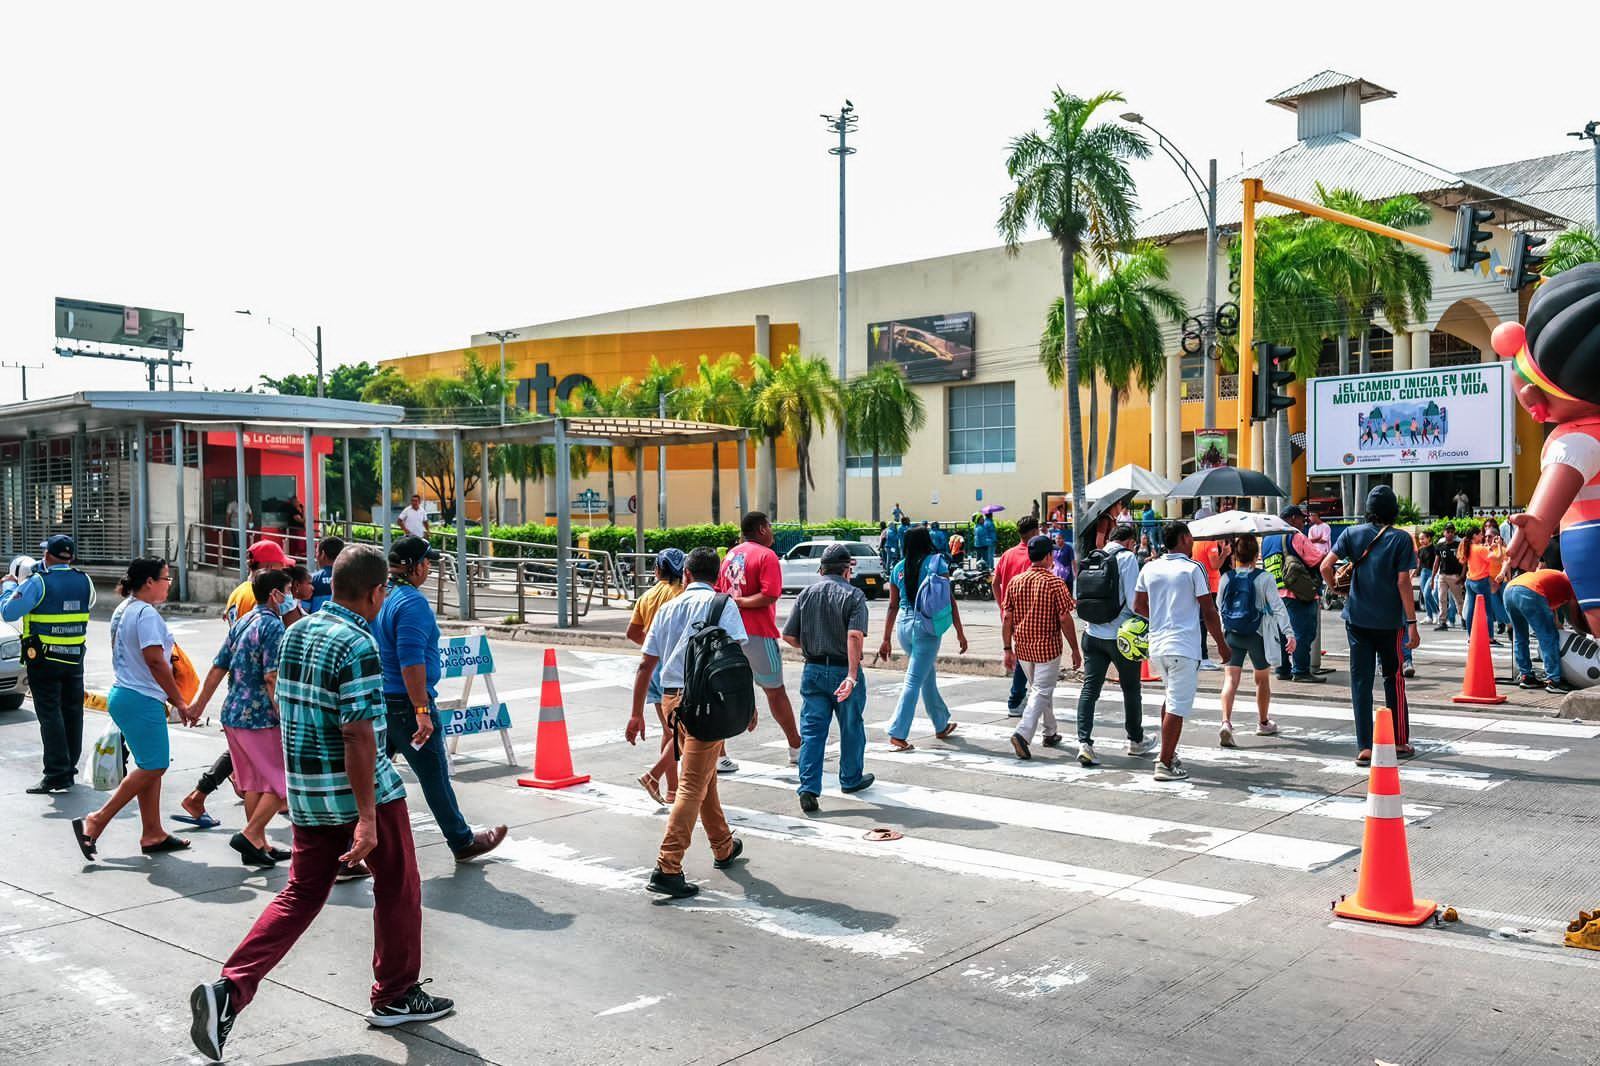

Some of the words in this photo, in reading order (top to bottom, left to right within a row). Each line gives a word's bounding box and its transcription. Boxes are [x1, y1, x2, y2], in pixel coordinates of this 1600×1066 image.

[1358, 379, 1401, 392] CAMBIO
[1404, 376, 1439, 388] INICIA
[1442, 374, 1457, 386] EN
[1400, 386, 1448, 400] CULTURA
[1451, 385, 1458, 396] Y
[1461, 383, 1489, 395] VIDA
[253, 433, 263, 443] La
[453, 706, 490, 720] DATT
[443, 719, 509, 735] EDUVIAL
